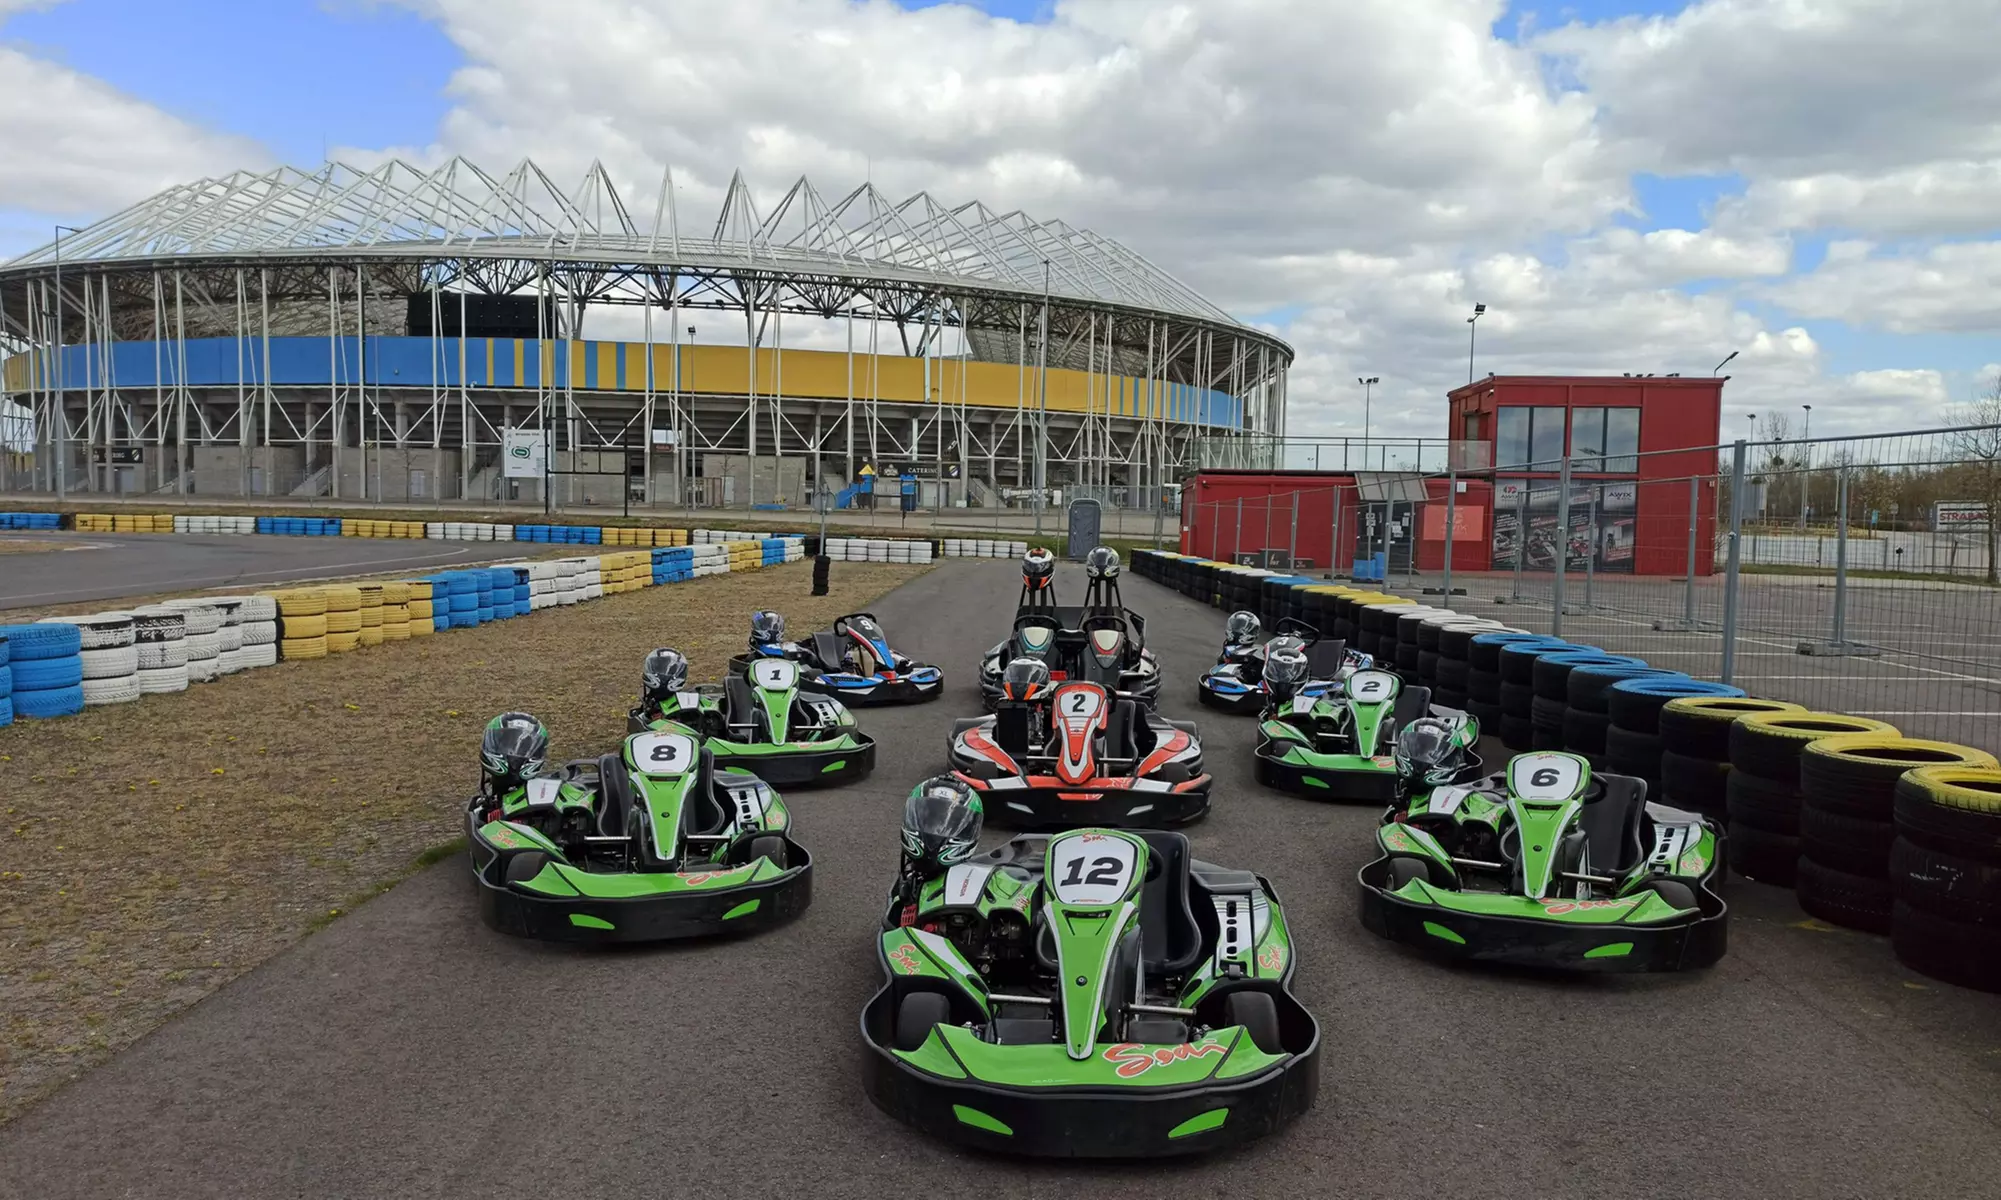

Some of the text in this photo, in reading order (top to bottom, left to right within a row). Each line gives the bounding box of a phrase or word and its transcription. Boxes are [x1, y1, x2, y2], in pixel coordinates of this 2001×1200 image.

[860, 620, 873, 630] 9
[1277, 636, 1289, 646] 3
[769, 669, 782, 680] 1
[1361, 681, 1381, 692] 2
[1072, 694, 1086, 712] 2
[650, 745, 677, 761] 8
[1530, 768, 1560, 787] 6
[1060, 856, 1123, 886] 12
[1103, 1039, 1228, 1079] Sodi
